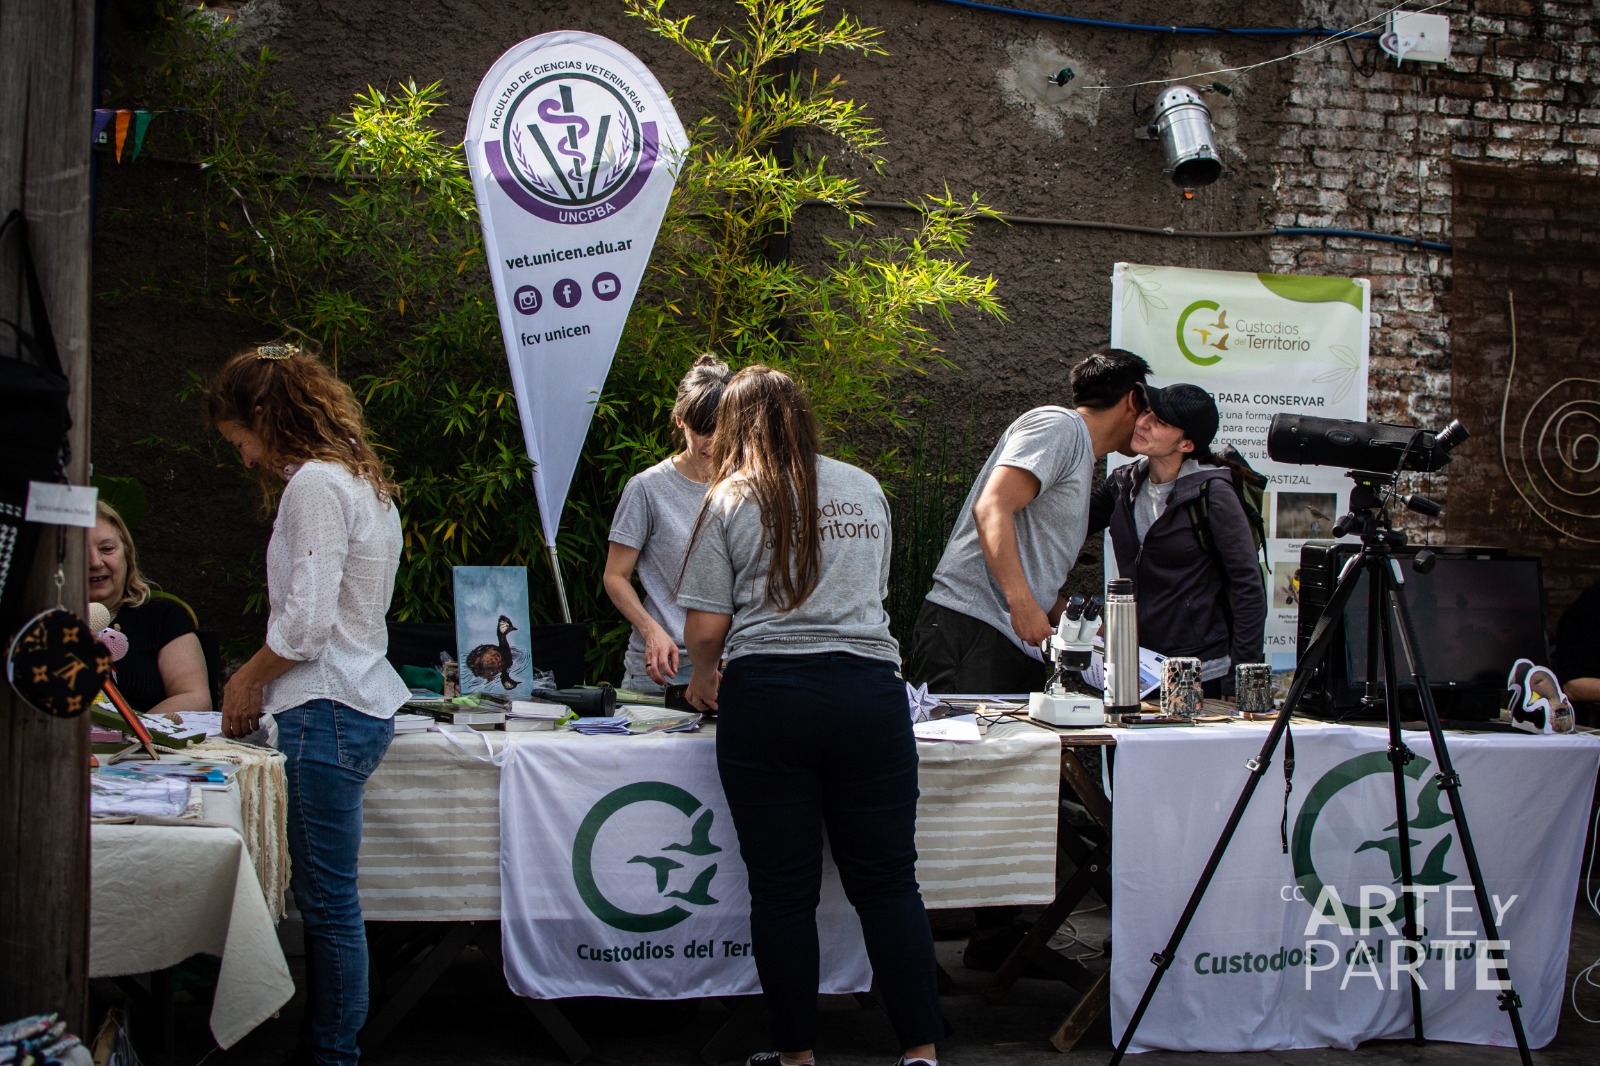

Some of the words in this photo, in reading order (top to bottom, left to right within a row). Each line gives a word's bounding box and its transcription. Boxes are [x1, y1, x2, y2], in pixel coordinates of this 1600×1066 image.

[490, 81, 519, 130] FACULTAD
[518, 70, 534, 84] DE
[534, 60, 582, 75] CIENCIAS
[585, 62, 646, 113] VETERINARIAS
[558, 202, 617, 223] UNCPBA
[506, 239, 633, 270] vet.unicen.edu.ar
[521, 332, 541, 347] fcv
[544, 324, 591, 342] unicen
[1235, 319, 1299, 335] Custodios
[1234, 337, 1246, 346] del
[1246, 334, 1310, 352] Territorio
[1218, 393, 1250, 404] PARA
[1253, 394, 1325, 407] CONSERVAR
[1226, 412, 1243, 420] una
[1245, 410, 1272, 421] forma
[1222, 424, 1243, 434] para
[1249, 451, 1260, 459] su
[576, 940, 675, 963] Custodios
[683, 939, 714, 959] del
[1345, 939, 1384, 966] del
